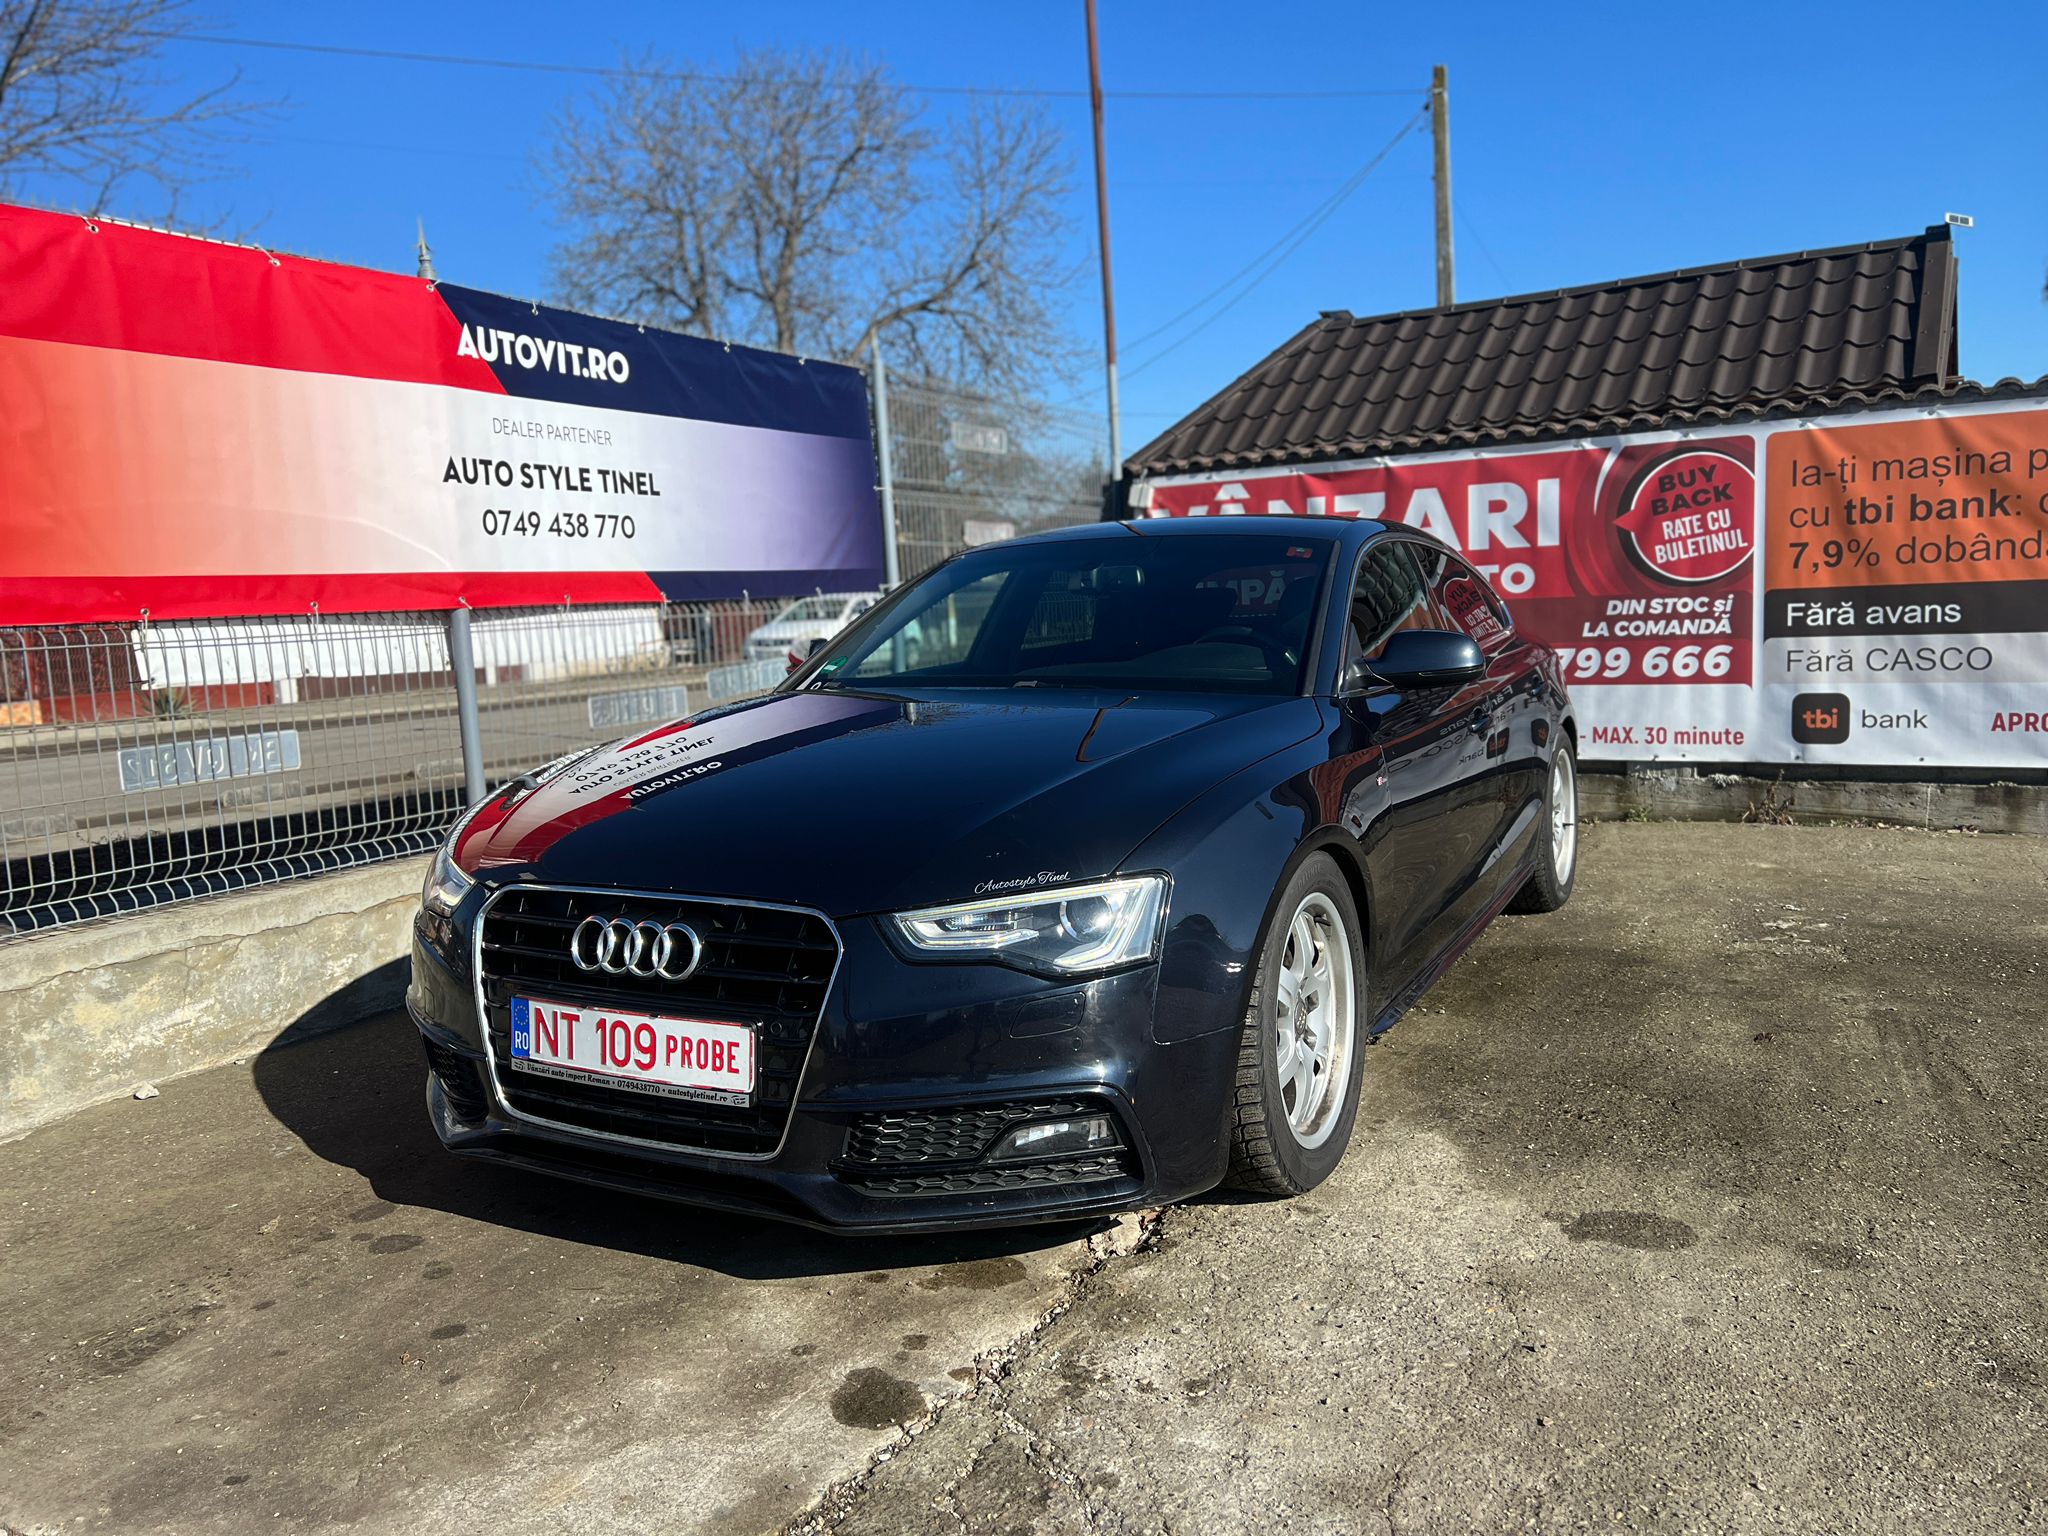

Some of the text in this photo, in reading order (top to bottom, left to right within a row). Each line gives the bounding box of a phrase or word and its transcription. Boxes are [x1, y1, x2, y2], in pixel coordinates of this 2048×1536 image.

[457, 323, 629, 384] AUTOVIT.RO
[493, 417, 612, 446] DEALER PARTENER
[443, 456, 661, 497] AUTO STYLE TINEL
[1658, 464, 1717, 494] BUY
[1872, 447, 2012, 488] mașina
[1651, 483, 1734, 516] BACK
[1789, 505, 1831, 529] cu
[1844, 494, 1894, 525] tbi
[1909, 487, 2022, 522] bank:
[482, 509, 635, 539] 0749 438 770
[1662, 508, 1732, 540] RATE CU
[1654, 529, 1749, 564] BULETINUL
[1789, 530, 2048, 574] 7,9% dobând
[1606, 599, 1646, 616] DIN
[1649, 596, 1710, 615] STOC
[1786, 601, 1962, 627] Fără avans
[1582, 613, 1732, 638] LA COMANDĂ
[1642, 644, 1734, 678] 666
[1786, 646, 1993, 673] Fără CASCO
[1803, 708, 1928, 730] tbi bank
[1592, 726, 1639, 745] MAX.
[1644, 726, 1668, 745] 30
[1673, 726, 1745, 746] minute
[974, 870, 1071, 894] Autostyle Tinel
[514, 1030, 529, 1050] RO
[534, 1006, 740, 1075] NT 109 PROBE
[617, 1079, 660, 1094] 0749438770
[668, 1088, 728, 1102] autostyletinel.ro
